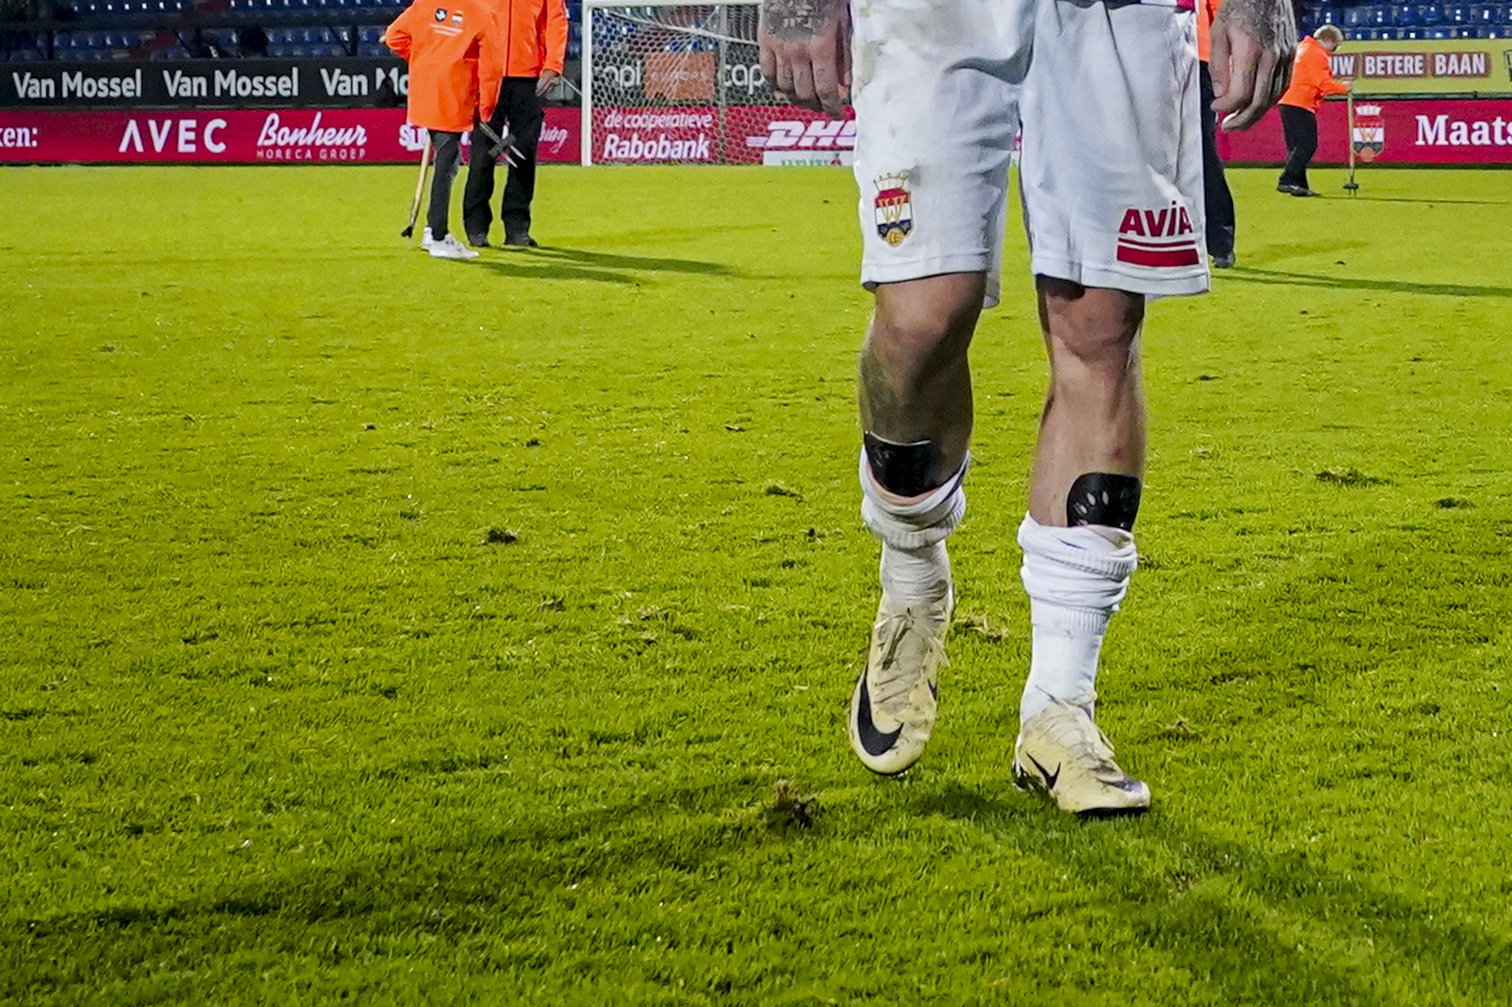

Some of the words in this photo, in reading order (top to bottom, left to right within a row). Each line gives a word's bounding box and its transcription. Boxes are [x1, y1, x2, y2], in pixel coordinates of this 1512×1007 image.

[1365, 54, 1424, 75] BETERE
[1435, 53, 1485, 75] BAAN
[12, 72, 55, 99] Van
[62, 69, 142, 98] Mossel
[163, 70, 207, 98] Van
[214, 67, 299, 97] Mossel
[320, 68, 368, 96] Van
[256, 111, 368, 146] Bonheur
[604, 110, 622, 129] de
[0, 126, 38, 147] en:
[118, 118, 227, 153] AVEC
[603, 132, 710, 159] Rabobank
[256, 148, 313, 160] HORECA
[319, 148, 367, 160] GROEP
[1119, 200, 1194, 237] AVIA
